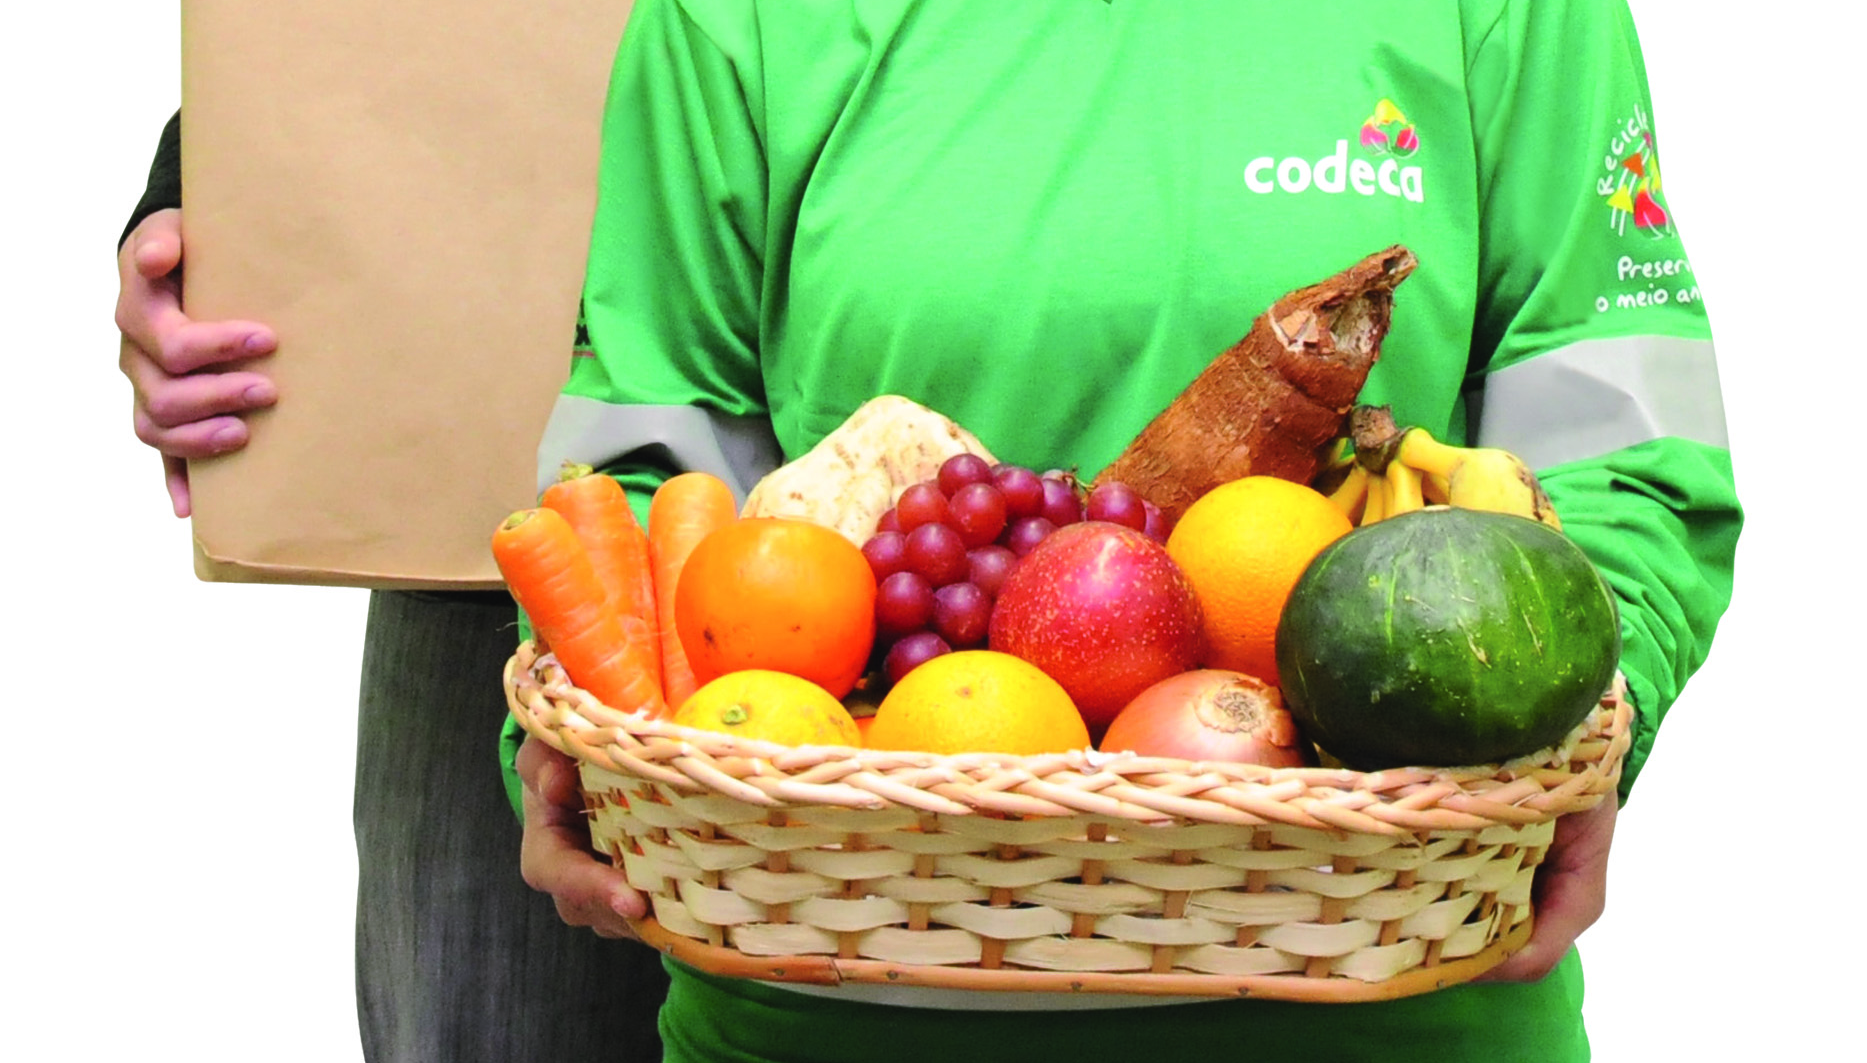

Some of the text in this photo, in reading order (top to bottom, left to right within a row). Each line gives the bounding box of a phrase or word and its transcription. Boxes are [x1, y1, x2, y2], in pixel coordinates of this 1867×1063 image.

[1244, 139, 1425, 203] codeca
[1617, 255, 1691, 281] Preser
[1595, 295, 1609, 313] o
[1616, 282, 1669, 309] meio
